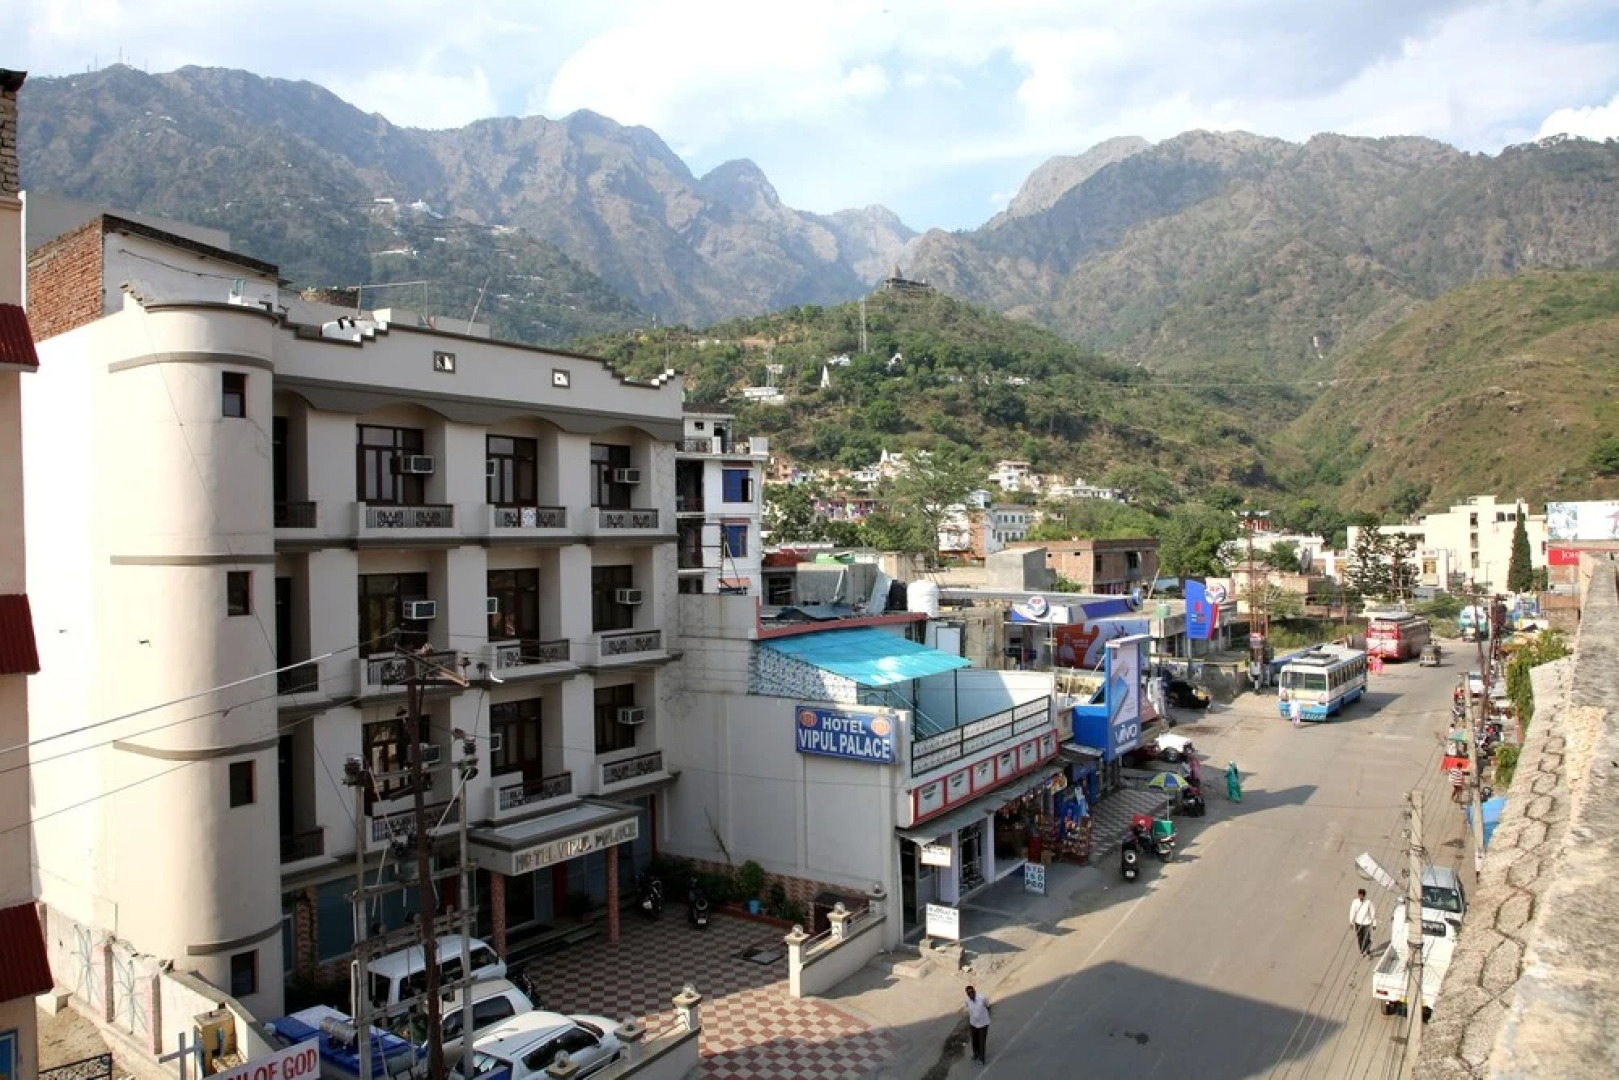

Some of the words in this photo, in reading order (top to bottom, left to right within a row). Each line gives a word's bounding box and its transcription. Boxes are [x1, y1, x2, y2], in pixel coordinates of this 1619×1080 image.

[1561, 551, 1580, 560] JOH
[822, 716, 866, 735] HOTEL
[798, 728, 837, 752] VIPUL
[839, 733, 890, 759] PALACE
[514, 846, 552, 873] HOTEL
[254, 1061, 278, 1080] OF
[283, 1048, 317, 1079] GOD
